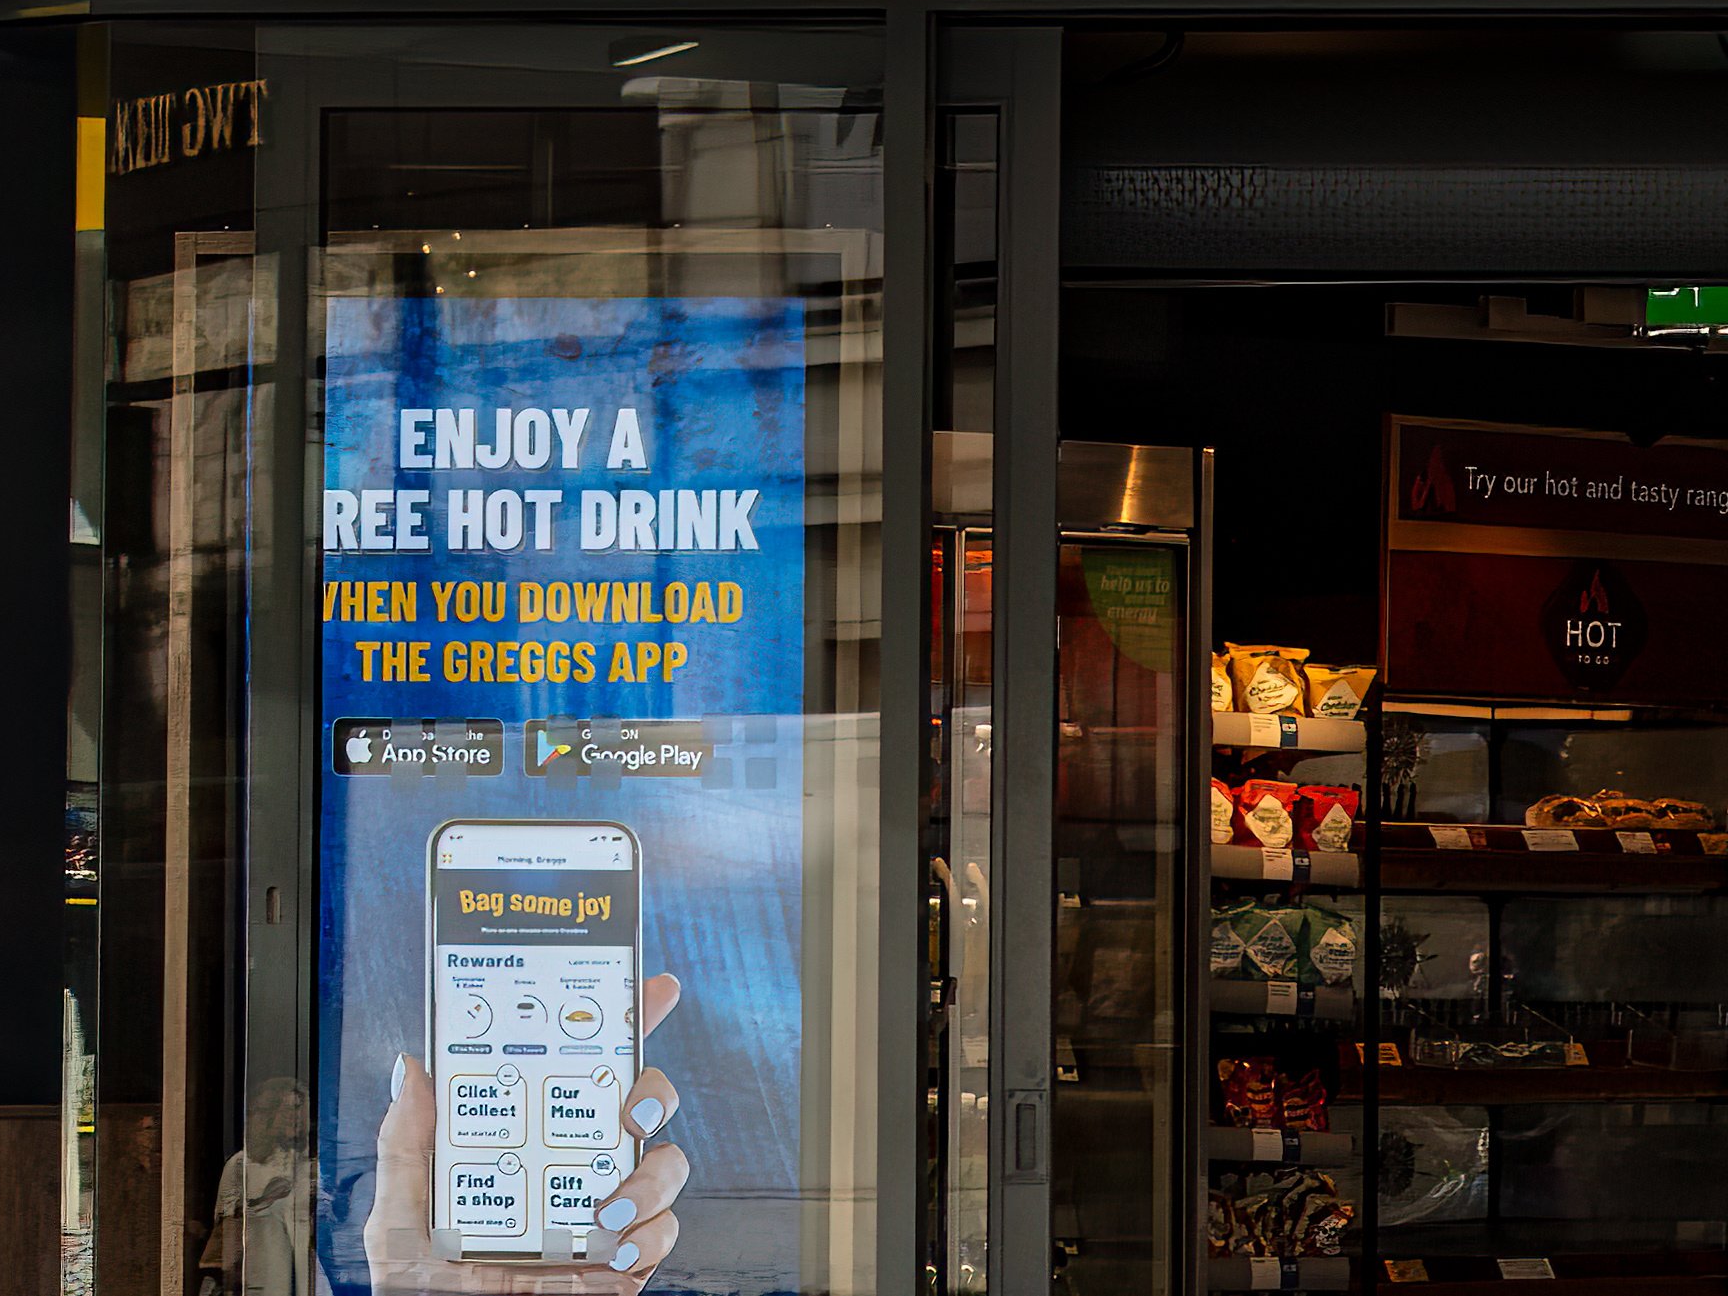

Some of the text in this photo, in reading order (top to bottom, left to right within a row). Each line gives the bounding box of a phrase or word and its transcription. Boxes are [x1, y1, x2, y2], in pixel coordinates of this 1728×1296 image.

[399, 407, 649, 471] ENJOY A
[1465, 466, 1497, 499] Try
[1503, 475, 1538, 495] our
[1545, 471, 1579, 498] hot
[1586, 476, 1624, 501] and
[1631, 480, 1680, 511] tasty
[447, 489, 563, 550] HOT
[580, 489, 760, 551] DRINK
[431, 580, 506, 623] YOU
[519, 580, 744, 624] DOWNLOAD
[1566, 619, 1622, 648] HOT
[355, 640, 689, 683] THE GREGGS APP
[381, 743, 491, 764] App Store
[581, 743, 703, 771] Google Play
[459, 889, 612, 923] Bag some joy
[448, 954, 524, 968] Rewards
[457, 1085, 498, 1099] Click
[551, 1086, 580, 1099] Our
[457, 1104, 516, 1117] Collect
[551, 1105, 595, 1118] Menu
[457, 1174, 495, 1188] Find
[550, 1176, 583, 1190] Gift
[457, 1193, 515, 1210] a shop
